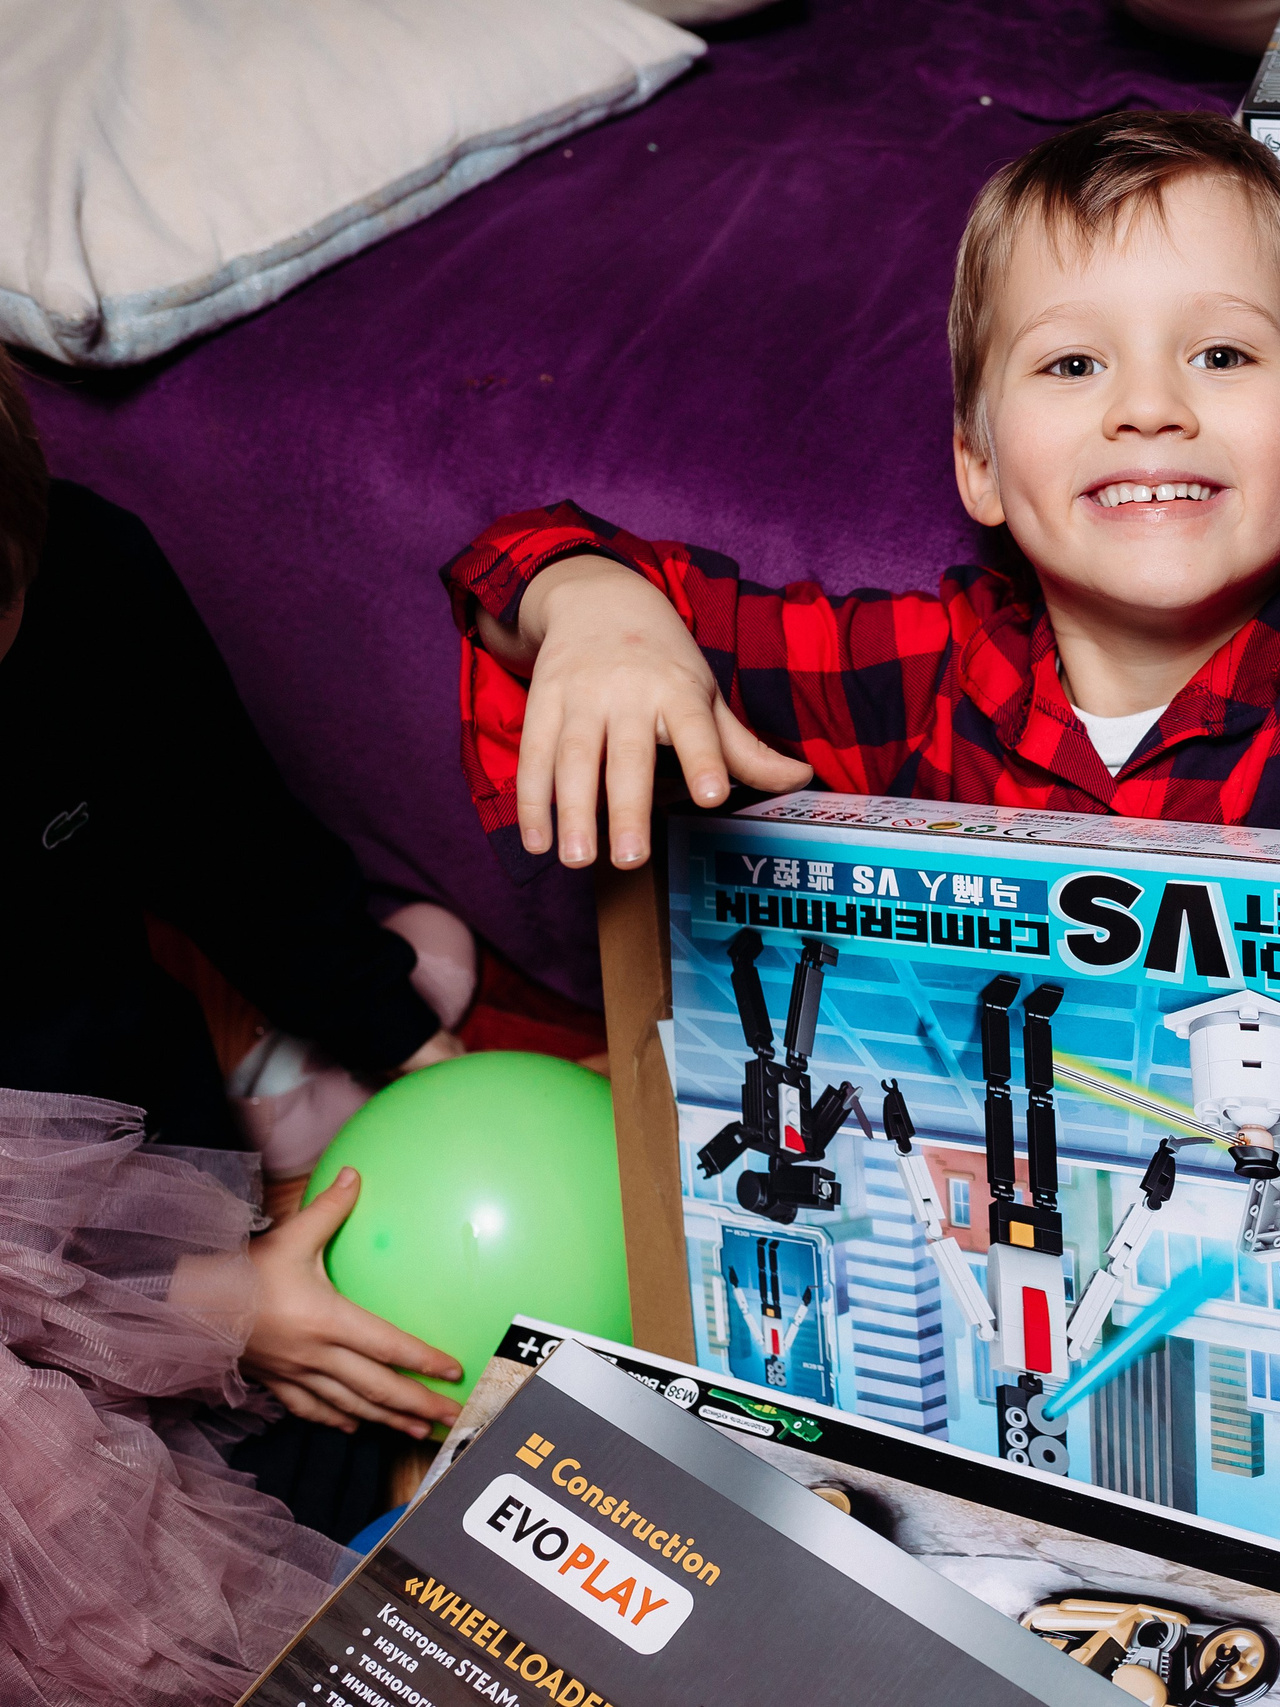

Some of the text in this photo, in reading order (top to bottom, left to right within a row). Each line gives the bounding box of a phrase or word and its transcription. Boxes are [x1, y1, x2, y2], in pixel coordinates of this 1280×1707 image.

[741, 854, 1021, 910] 马桶人 VS 监控人
[714, 889, 1051, 956] CAMERAMAN
[1057, 873, 1233, 981] VS
[666, 1384, 698, 1404] M38
[551, 1457, 721, 1587] Construction
[485, 1494, 670, 1627] EVOPLAY
[373, 1635, 420, 1674] наука
[376, 1602, 456, 1669] Категория
[404, 1576, 616, 1707] «WHEEL LOADE
[326, 1690, 354, 1707] тв
